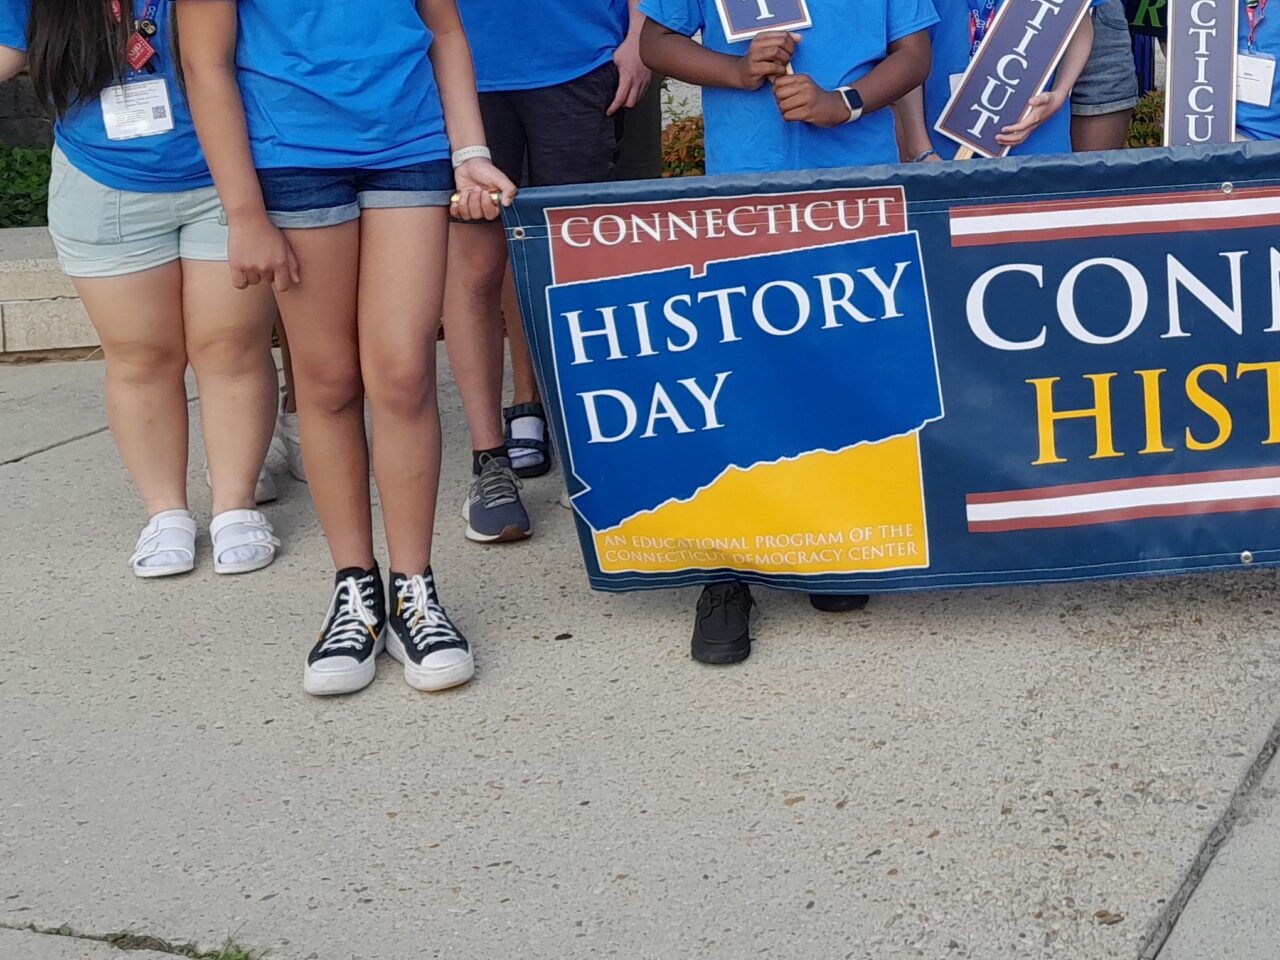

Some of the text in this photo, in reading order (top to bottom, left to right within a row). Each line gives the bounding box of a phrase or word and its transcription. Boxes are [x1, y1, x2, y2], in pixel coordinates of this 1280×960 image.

[560, 197, 895, 247] CONNECTICUT
[560, 261, 911, 367] HISTORY
[576, 371, 733, 444] DAY
[603, 523, 913, 551] AN EDUCATIONAL PROGRAM OF THE
[604, 541, 918, 566] CONNECTICUT DEMOCRACY CENTER
